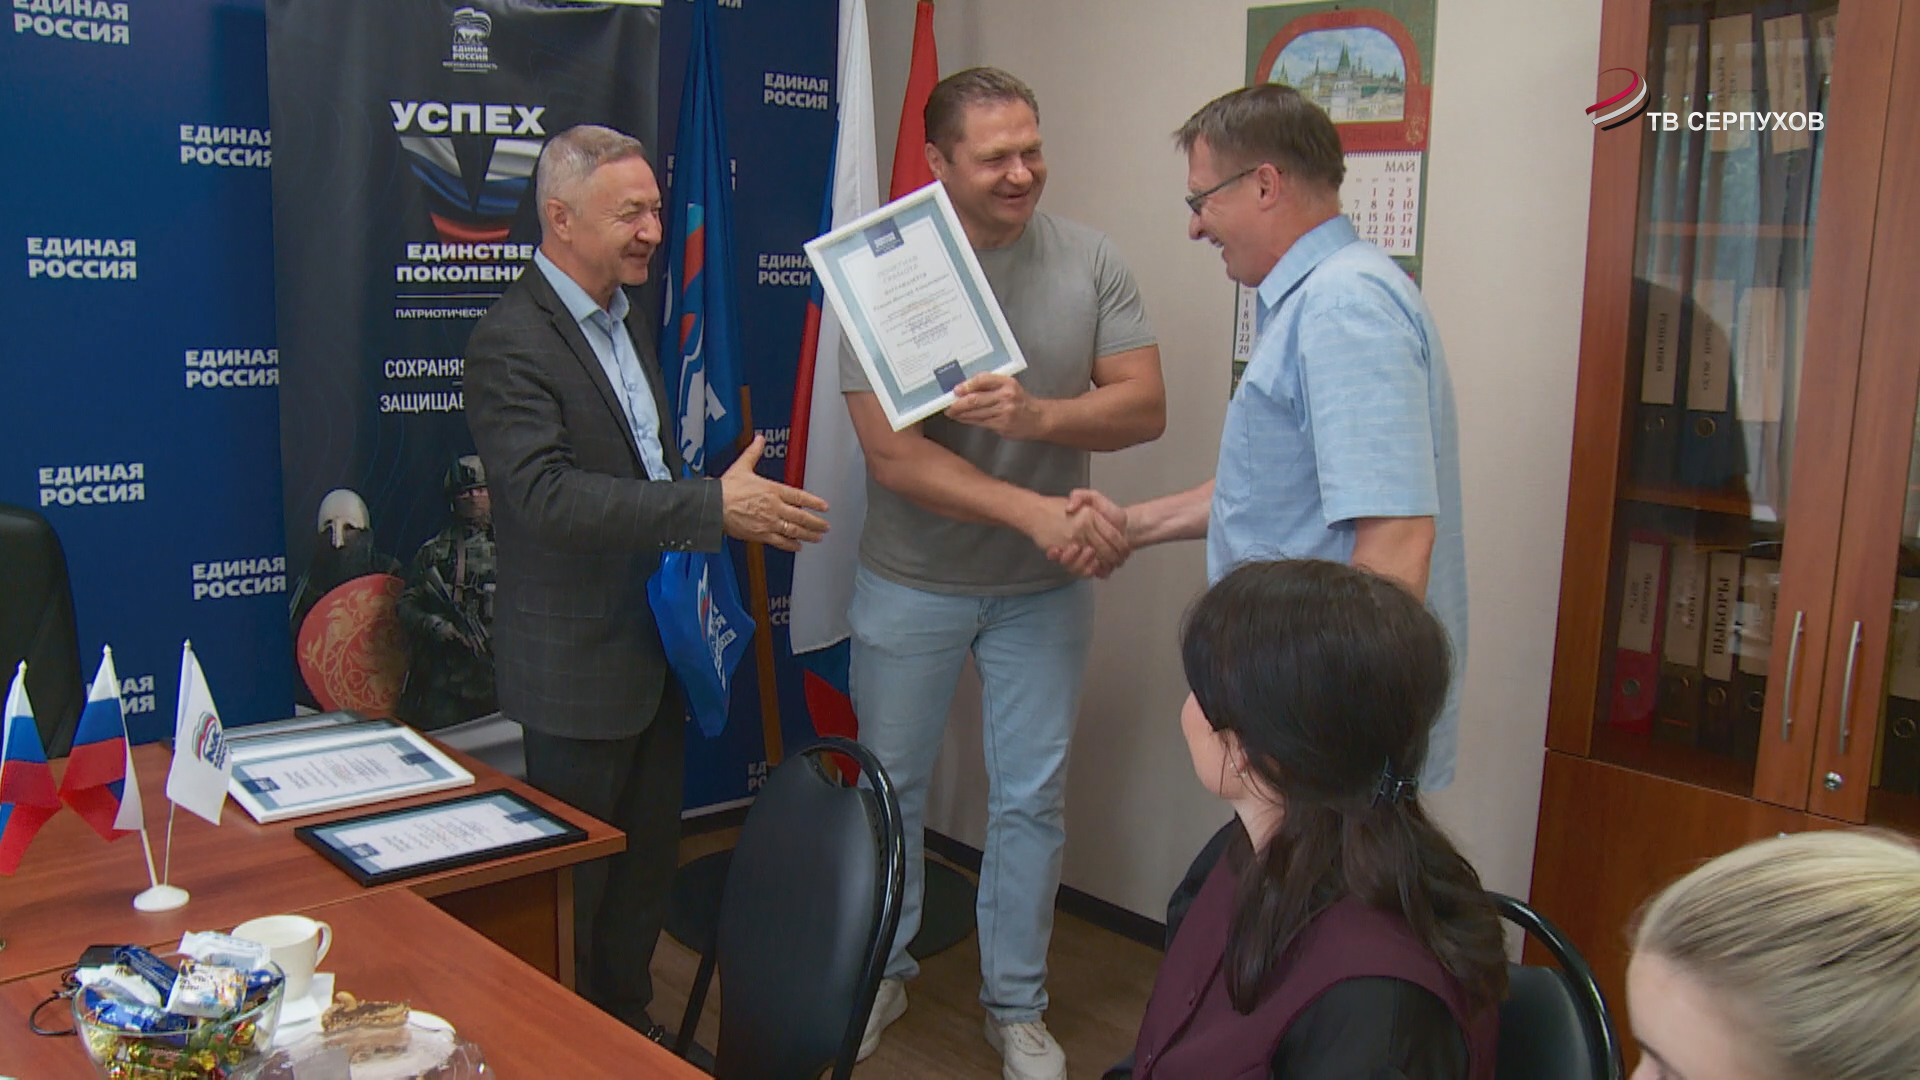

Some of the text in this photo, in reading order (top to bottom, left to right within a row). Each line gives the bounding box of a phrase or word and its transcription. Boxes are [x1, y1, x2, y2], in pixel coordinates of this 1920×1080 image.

[13, 0, 129, 21] ЕДИНАЯ
[14, 13, 129, 44] РОССИЯ
[764, 72, 829, 93] ЕДИНАЯ
[763, 89, 828, 110] РОССИЯ
[390, 101, 546, 135] УСПЕХ
[1385, 160, 1415, 173] МАЙ
[1389, 187, 1395, 197] 2
[1354, 199, 1414, 210] 7 8 9 10
[1351, 212, 1413, 223] 14 15 16 17
[1367, 225, 1378, 235] 22
[1401, 226, 1413, 235] 24
[27, 237, 136, 258] ЕДИНАЯ
[407, 243, 534, 261] ЕДИНСТВЕ
[28, 258, 137, 279] РОССИЯ
[758, 254, 812, 270] ЕДИНА
[758, 270, 811, 286] РОССИ
[1243, 310, 1249, 319] 8
[1241, 321, 1250, 331] 15
[1239, 333, 1250, 342] 22
[185, 349, 279, 368] ЕДИНАЯ
[1238, 345, 1249, 354] 29
[186, 368, 280, 388] РОССИЯ
[39, 463, 144, 486] ЕДИНАЯ
[40, 483, 145, 506] РОССИЯ
[192, 556, 286, 580] ЕДИНАЯ
[193, 575, 287, 600] РОССИЯ
